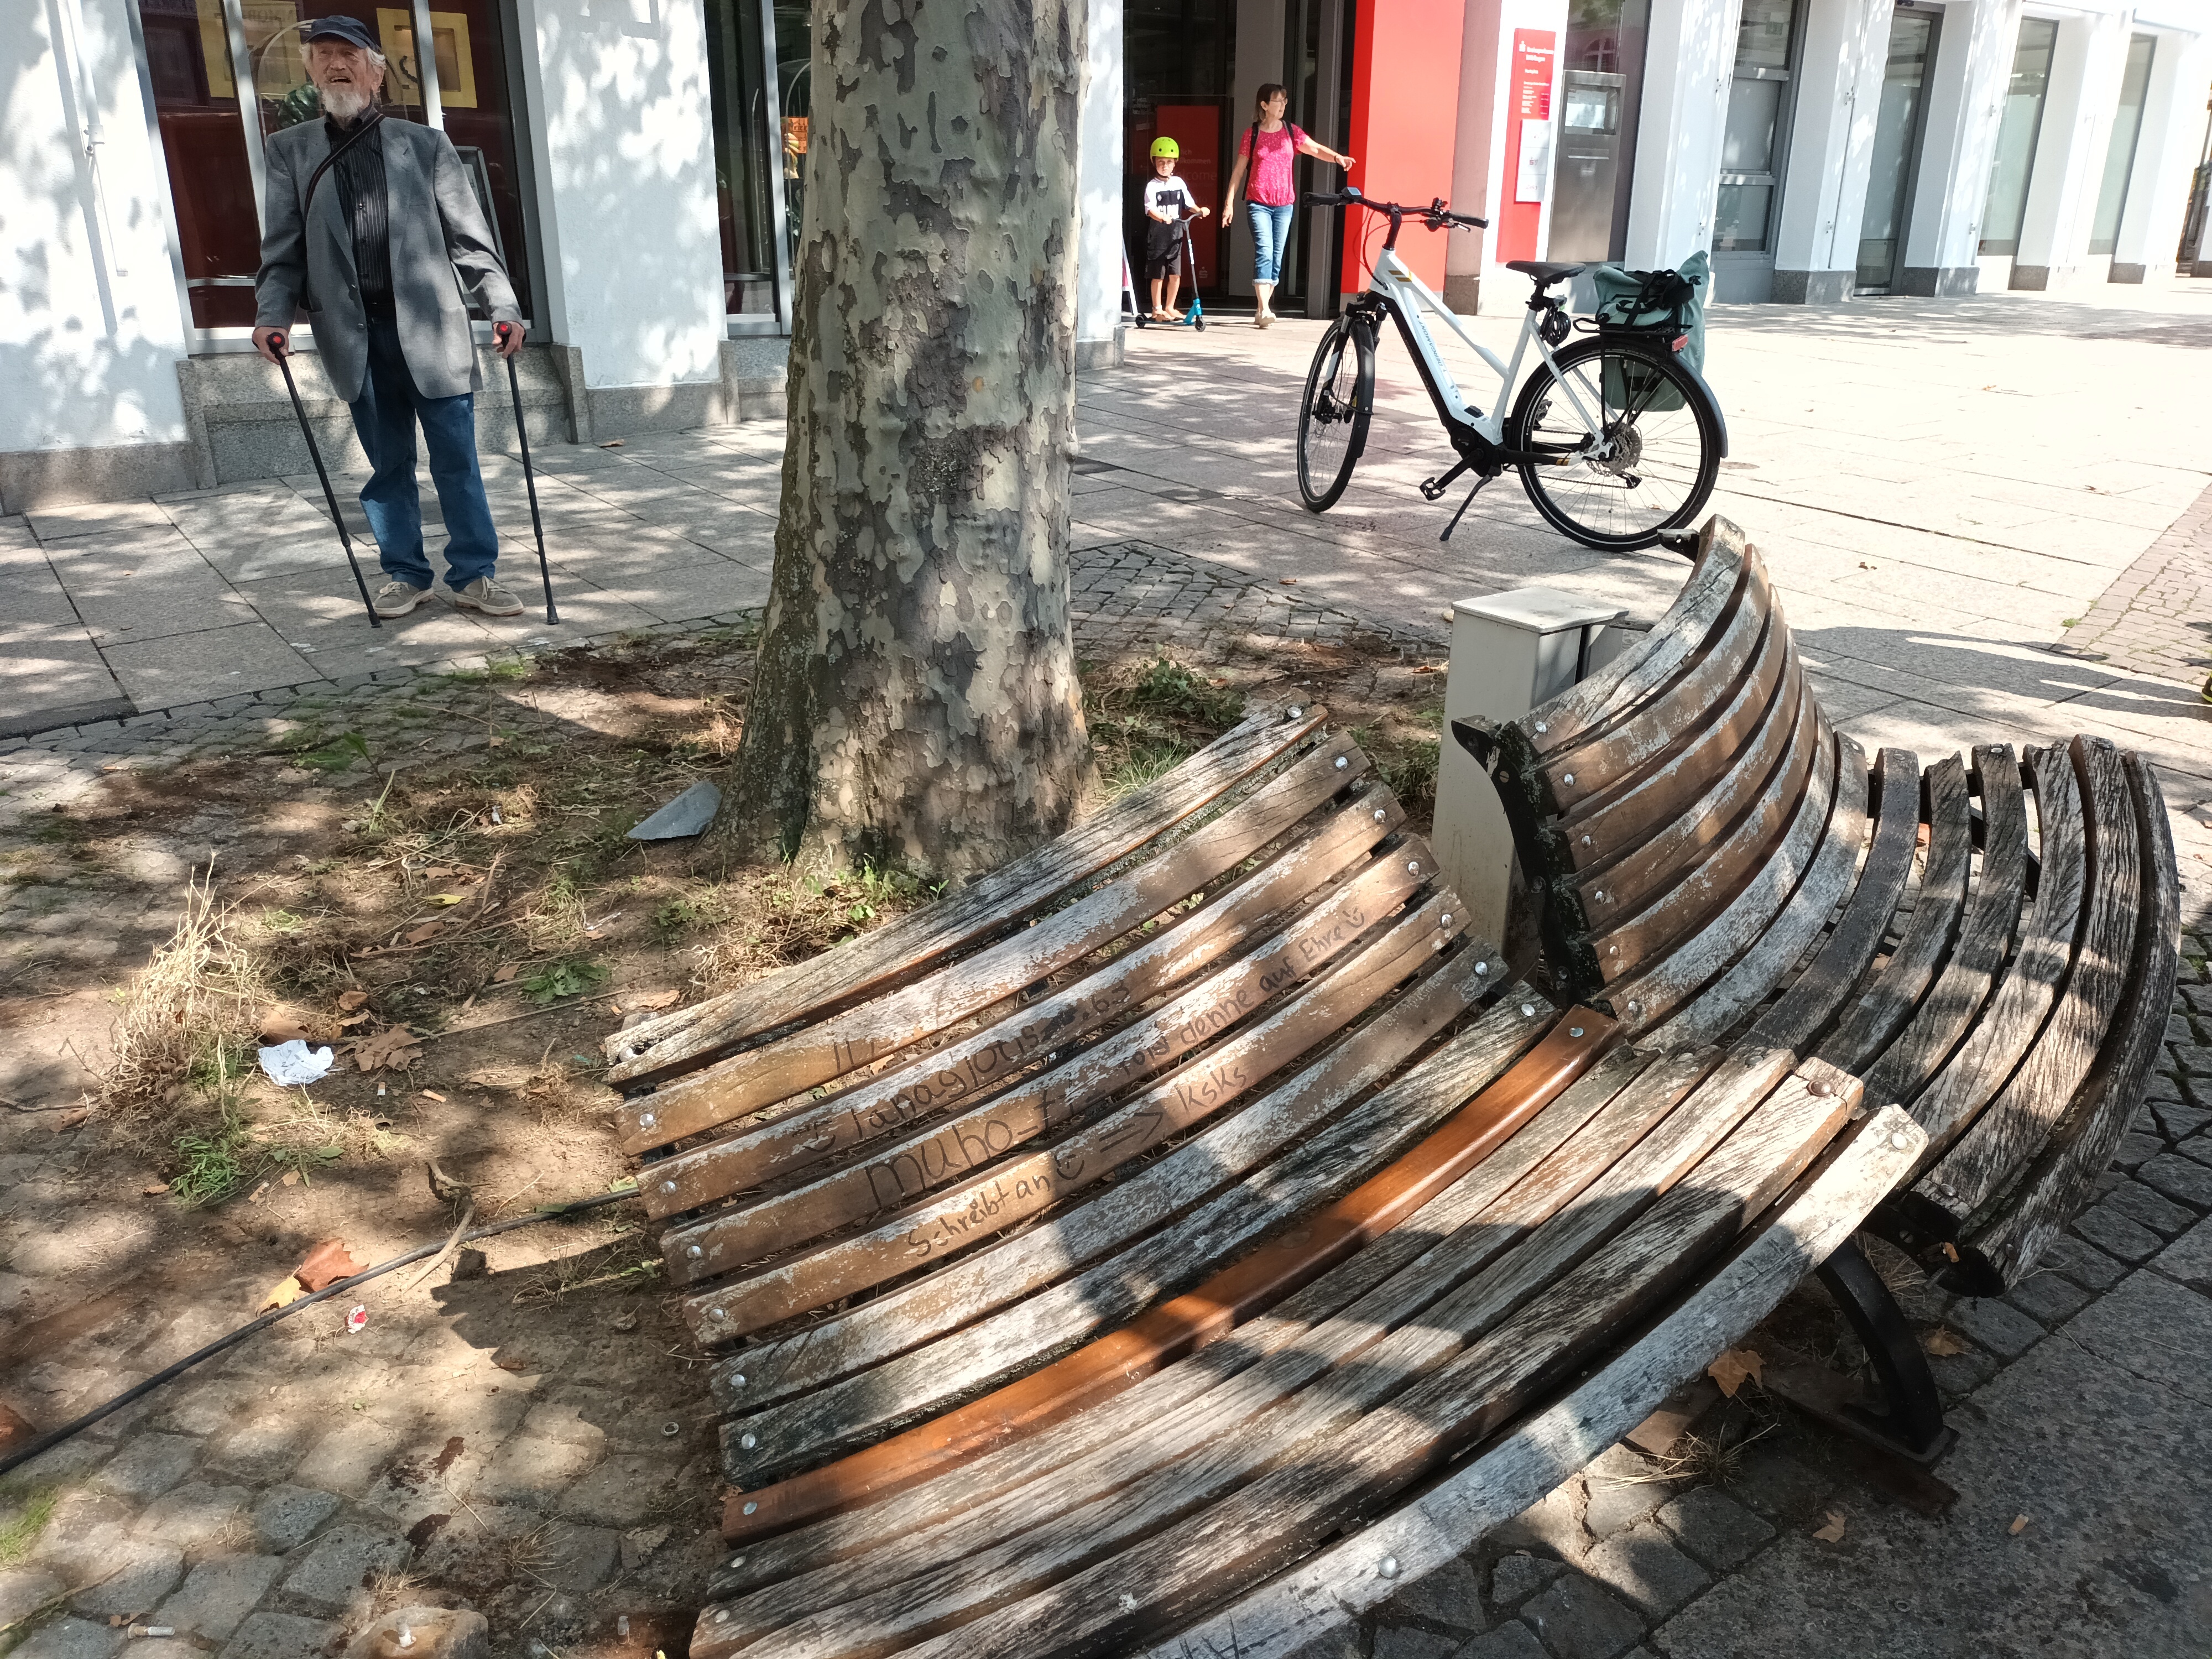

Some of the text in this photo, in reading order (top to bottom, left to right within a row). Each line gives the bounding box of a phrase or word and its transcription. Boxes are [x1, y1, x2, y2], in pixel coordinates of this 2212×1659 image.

[1259, 956, 1297, 993] auf
[1299, 926, 1343, 962] Ehre
[1016, 1174, 1051, 1199] an
